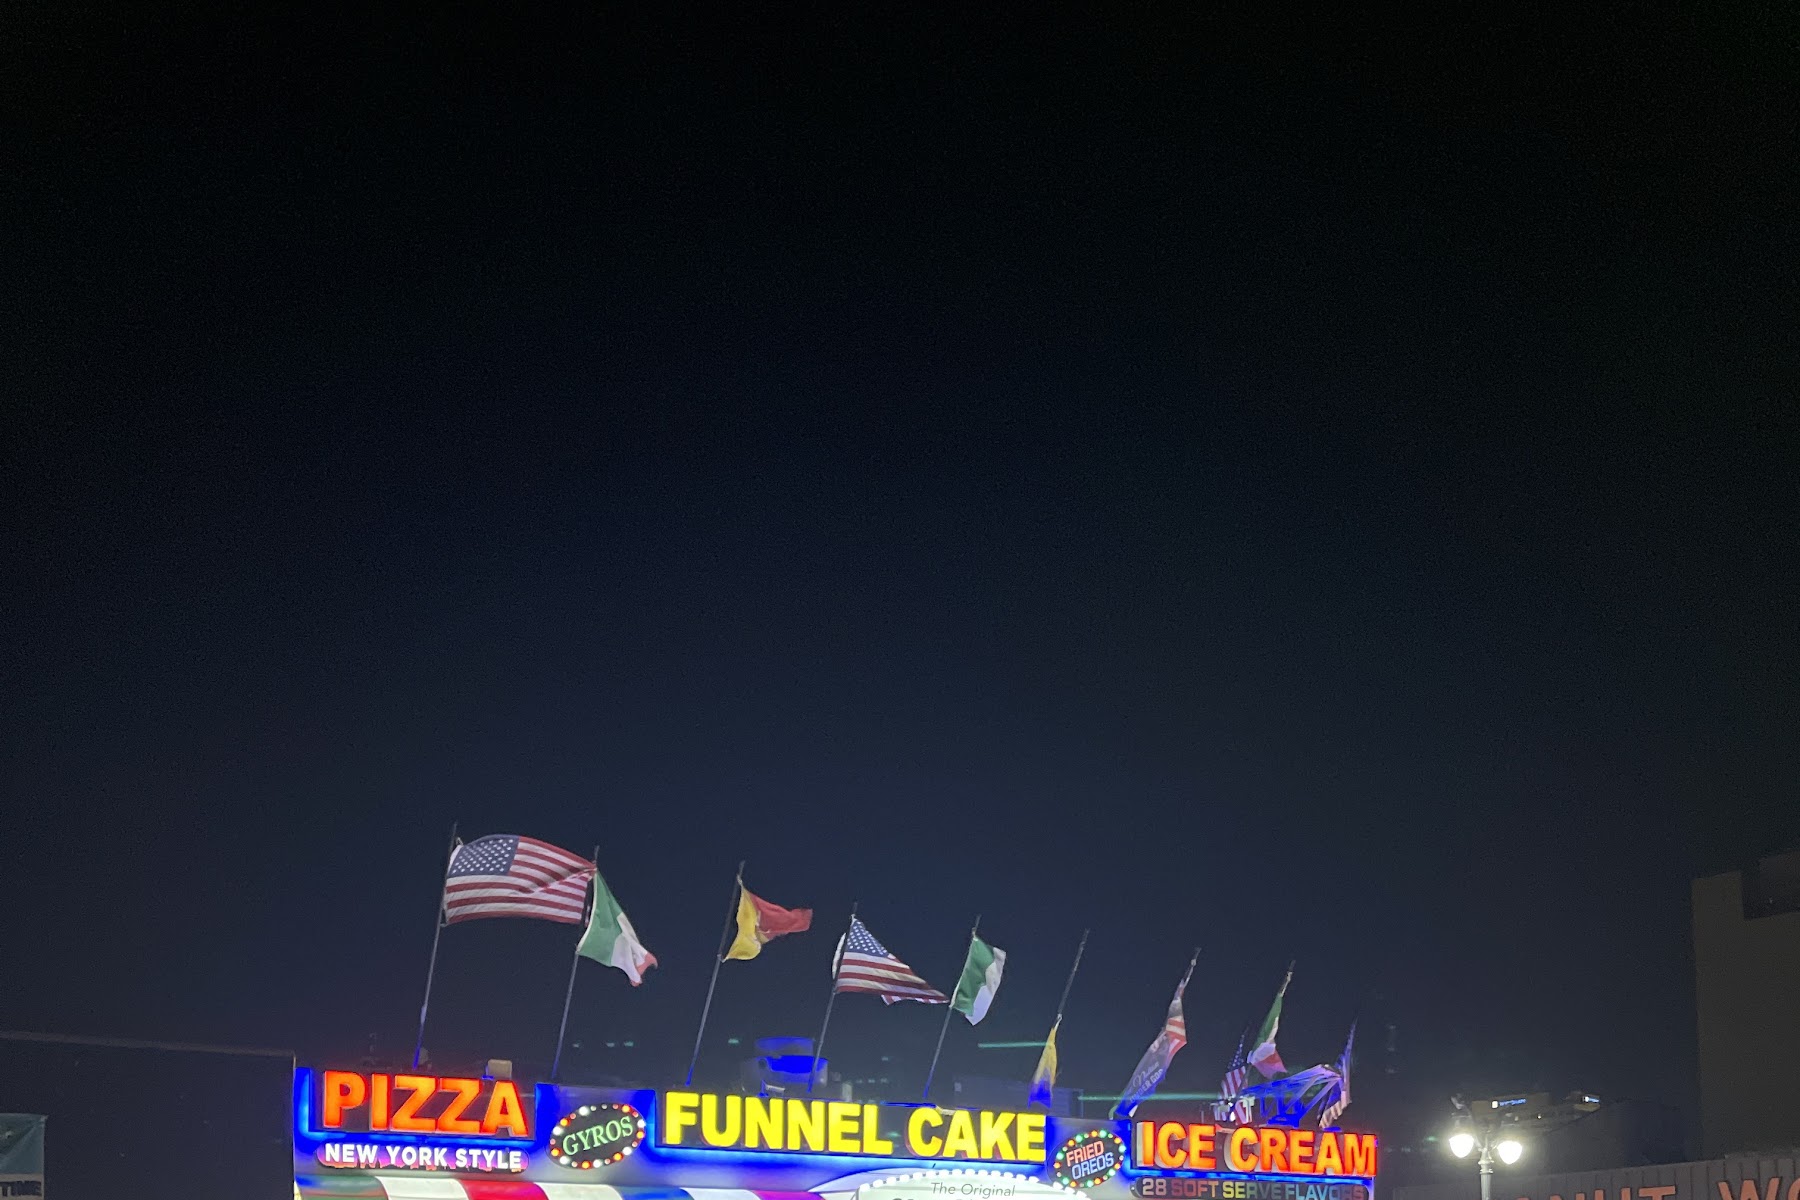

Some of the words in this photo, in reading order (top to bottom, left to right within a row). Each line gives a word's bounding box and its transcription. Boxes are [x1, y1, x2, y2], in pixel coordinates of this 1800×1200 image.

[323, 1070, 529, 1136] PIZZA
[562, 1116, 634, 1157] GYROS
[665, 1091, 893, 1155] FUNNEL
[908, 1107, 1047, 1163] CAKE
[324, 1143, 379, 1164] NEW
[385, 1146, 448, 1167] YORK
[455, 1149, 522, 1170] STYLE
[1066, 1140, 1105, 1168] FRIED
[1139, 1121, 1218, 1170] ICE
[1228, 1127, 1377, 1177] CREAM
[1071, 1151, 1115, 1181] OREOS
[931, 1182, 956, 1195] The
[960, 1183, 1016, 1199] Original
[1141, 1178, 1168, 1197] 28
[1171, 1180, 1219, 1198] SOFT
[1222, 1181, 1282, 1200] SERVE
